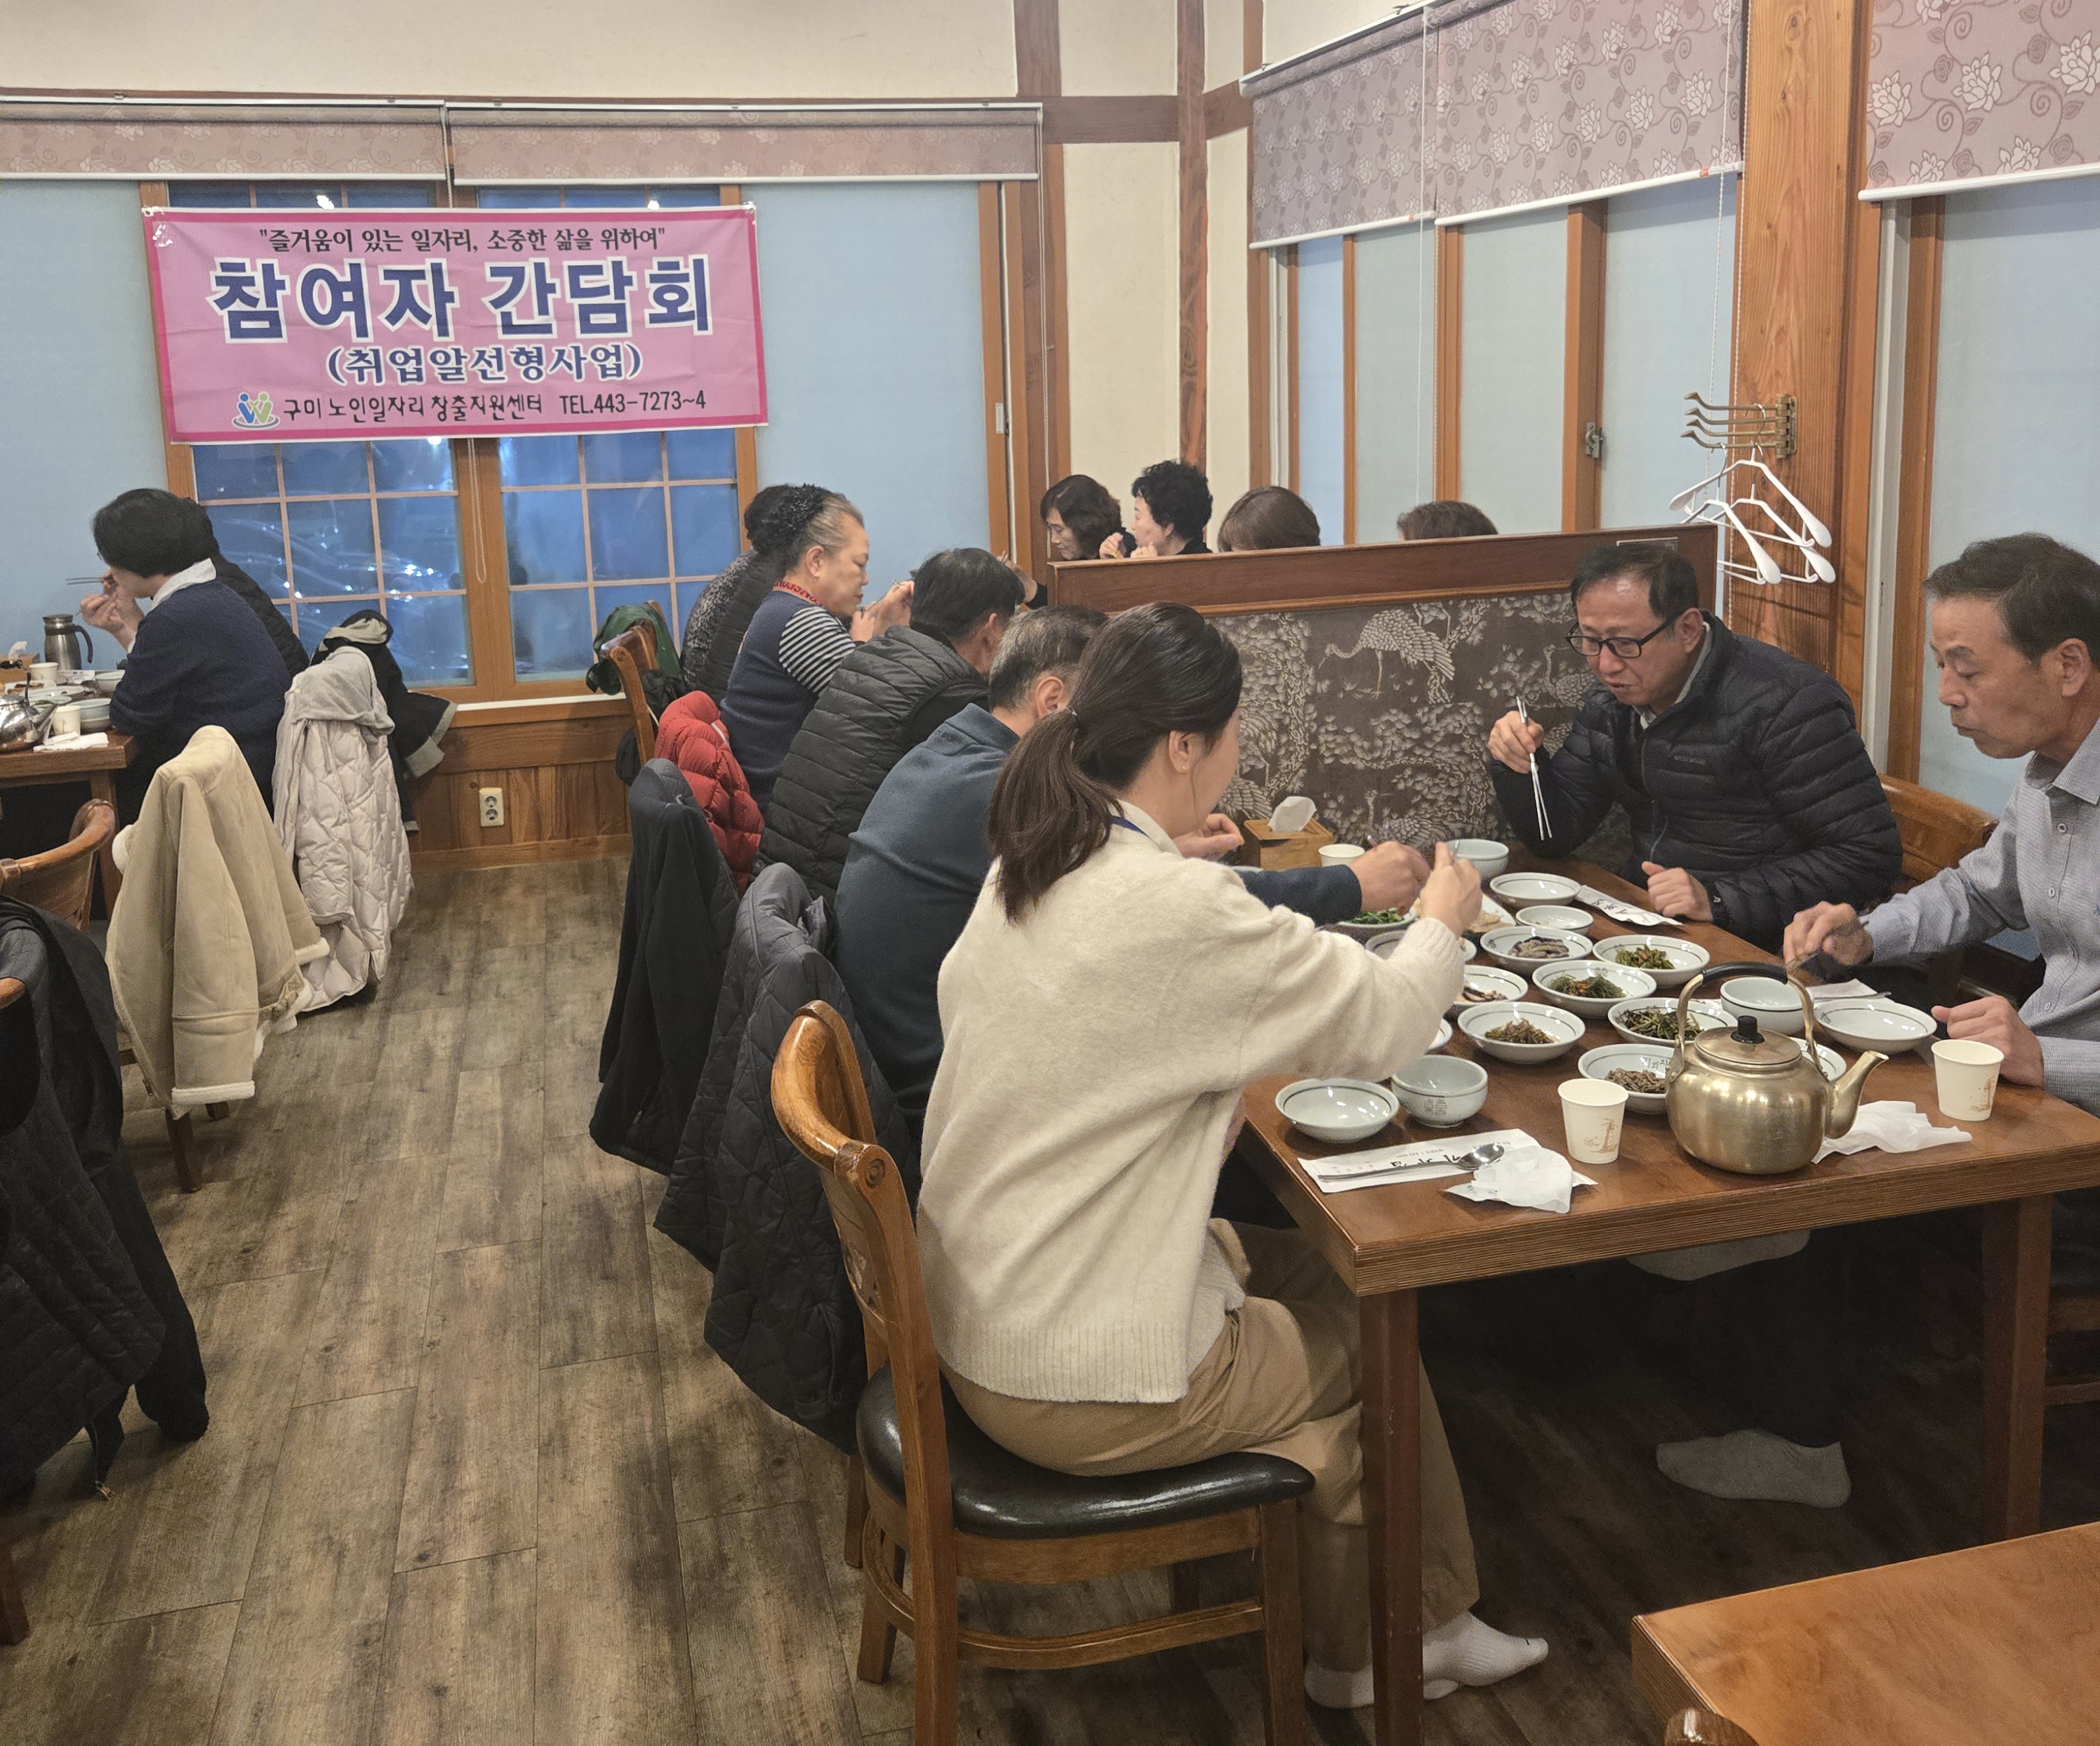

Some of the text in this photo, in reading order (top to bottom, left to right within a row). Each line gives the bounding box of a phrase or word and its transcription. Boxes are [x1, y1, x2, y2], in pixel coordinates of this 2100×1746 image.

[260, 227, 665, 253] "즐거움이 있는 일자리, 소중한 삶을 위하여"
[209, 256, 710, 341] 참여자 간담회
[327, 343, 642, 384] (취업알선형사업)
[284, 389, 706, 422] 구미 노인일자리 창출지원센터 TEL.443-7273~4
